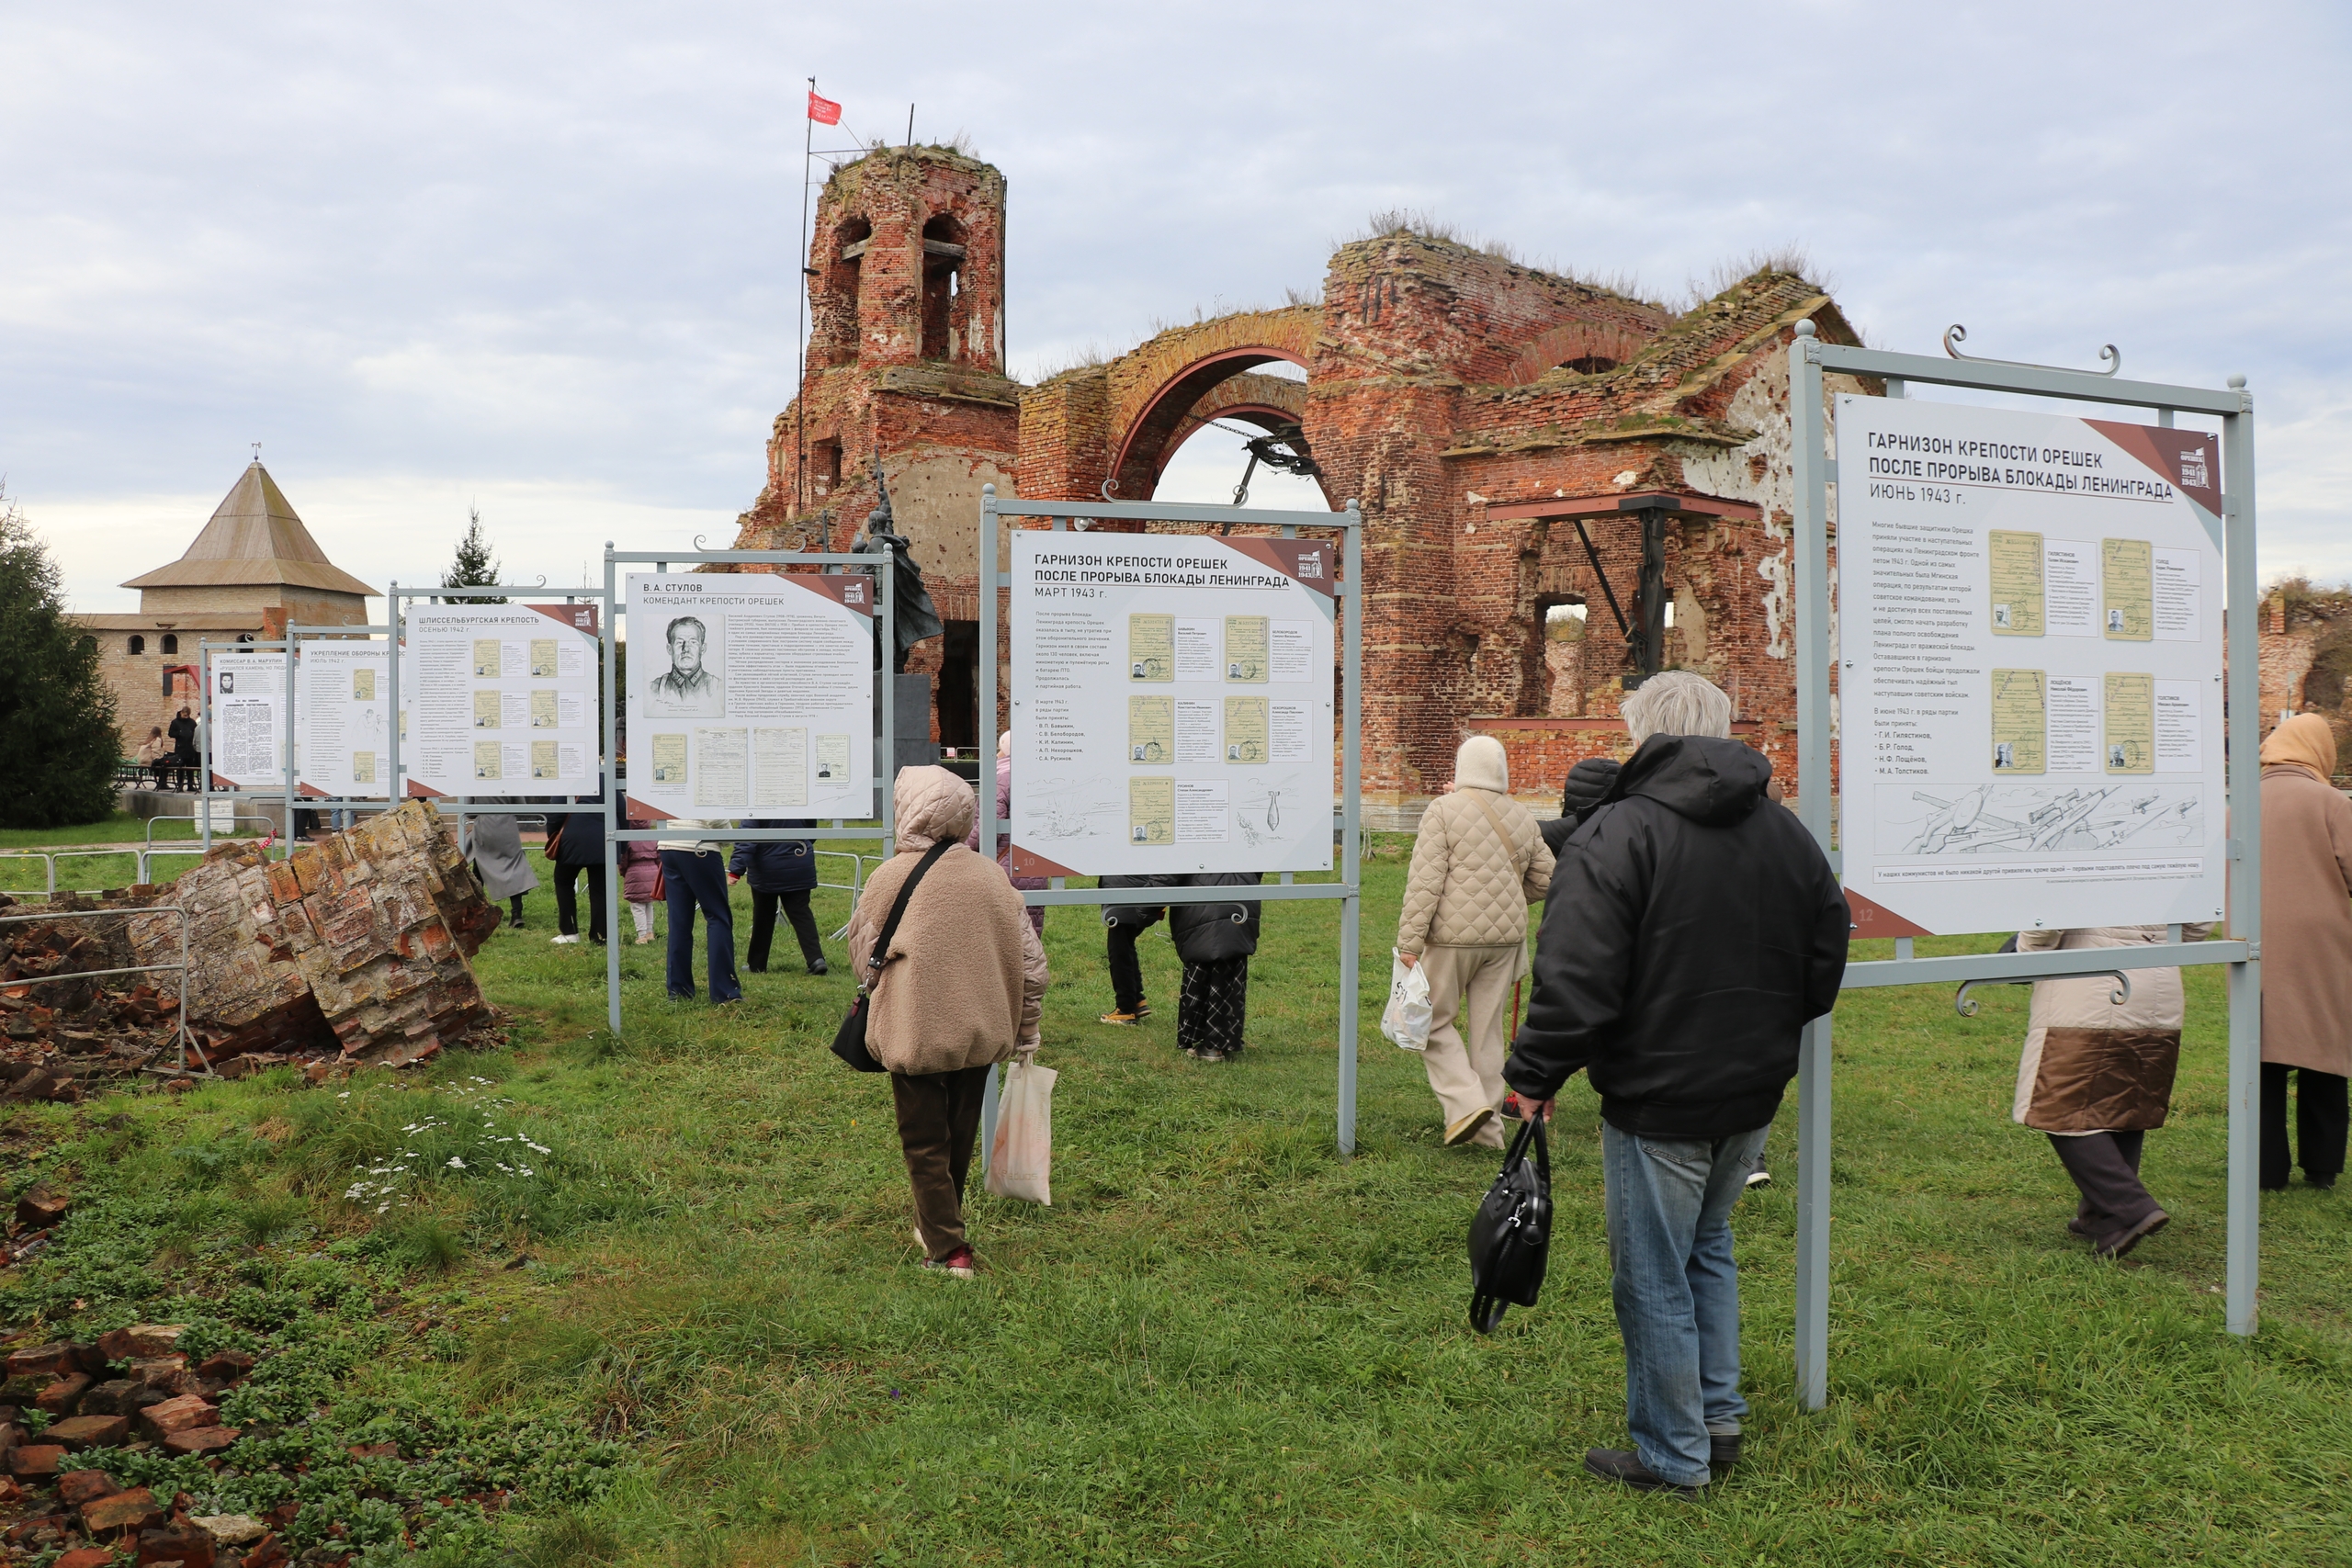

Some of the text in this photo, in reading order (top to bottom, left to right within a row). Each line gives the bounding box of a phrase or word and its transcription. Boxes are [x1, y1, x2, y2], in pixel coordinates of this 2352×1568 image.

[1869, 432, 2102, 468] ГАРНИЗОН КРЕПОСТИ ОРЕШЕК
[1870, 457, 2173, 500] ПОСЛЕ ПРОРЫВА БЛОКАДЫ ЛЕНИНГРАДА
[1871, 483, 1965, 504] ИЮНЬ 1943 г.
[1871, 521, 1894, 529] Многие
[1895, 522, 1918, 530] бывшие
[1951, 525, 1973, 535] Орешка
[1928, 537, 1973, 546] наступательных
[1914, 547, 1958, 557] Ленинградском
[1035, 554, 1227, 570] ГАРНИЗОН КРЕПОСТИ ОРЕШЕК
[1910, 558, 1929, 567] Одной
[1035, 570, 1291, 588] ПОСЛЕ ПРОРЫВА БЛОКАДЫ ЛЕНИНГРАДА
[1930, 571, 1958, 580] Мгинская
[665, 583, 703, 592] СТУЛОВ
[1035, 587, 1068, 597] МАРТ
[1071, 587, 1094, 598] 1943
[643, 596, 697, 605] КОМЕНДАНТ
[748, 597, 784, 605] ОРЕШЕК
[1887, 606, 1917, 615] достигнув
[1936, 620, 1968, 628] разработку
[1917, 630, 1959, 638] освобождения
[1873, 640, 1909, 649] Ленинграда
[1918, 642, 1949, 650] вражеской
[1873, 652, 1916, 660] Остававшиеся
[1902, 665, 1924, 673] Орешек
[1925, 666, 1944, 674] бойцы
